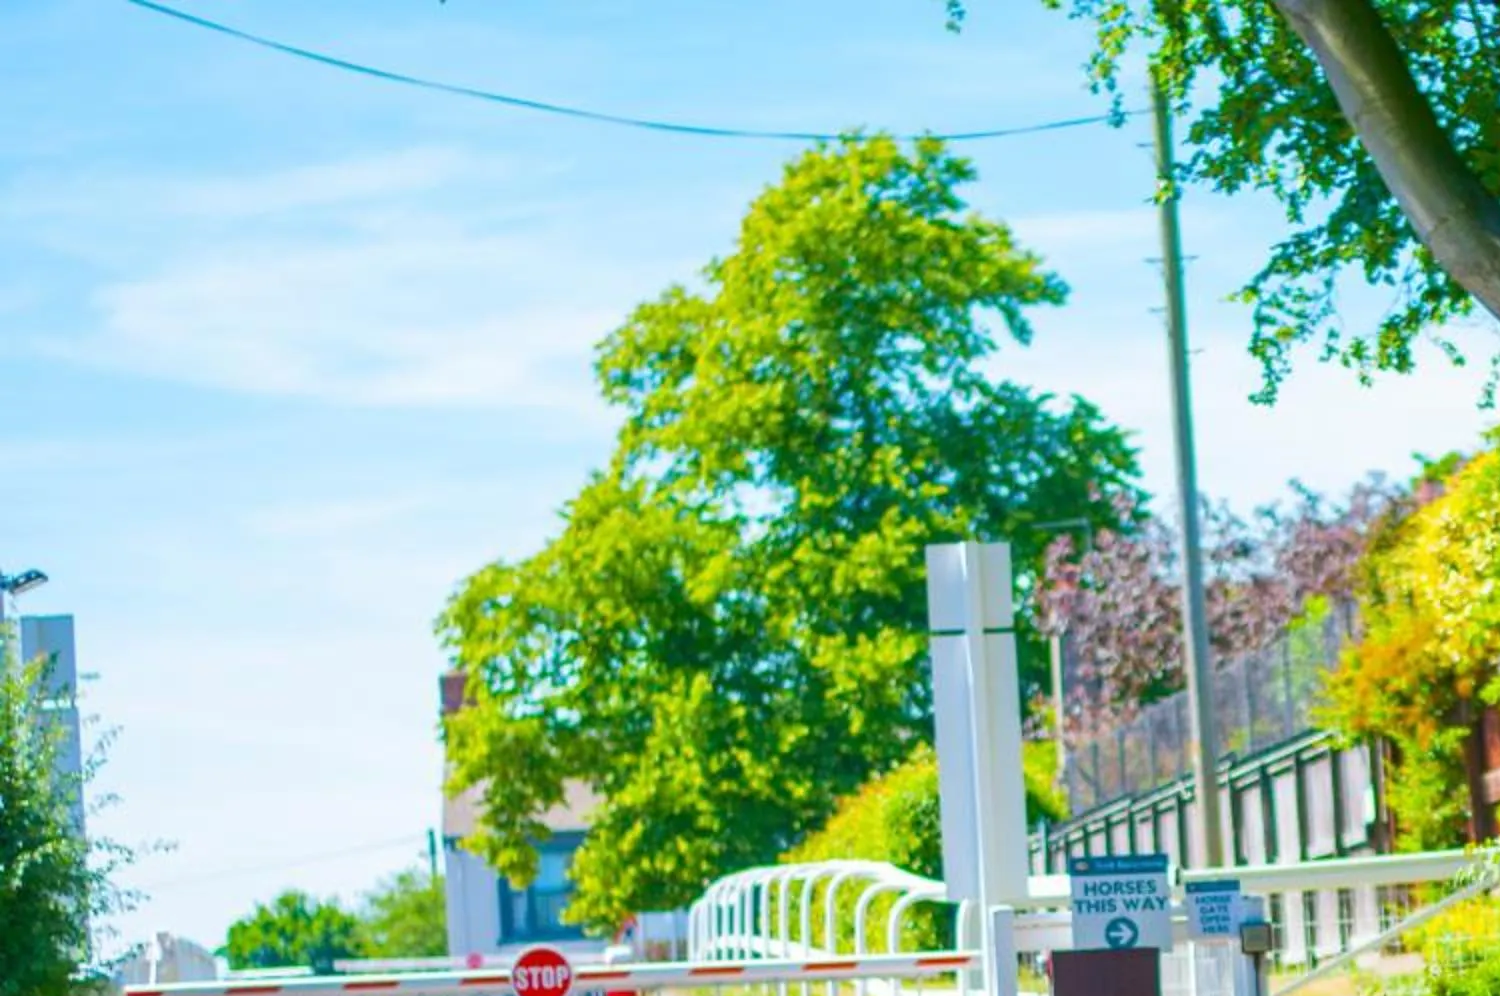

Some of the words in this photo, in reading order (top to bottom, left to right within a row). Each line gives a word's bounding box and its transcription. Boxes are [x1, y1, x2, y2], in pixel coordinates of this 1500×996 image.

[1083, 879, 1157, 897] HORSES
[1073, 898, 1118, 915] THIS
[1122, 896, 1168, 912] WAY
[515, 964, 569, 991] STOP
